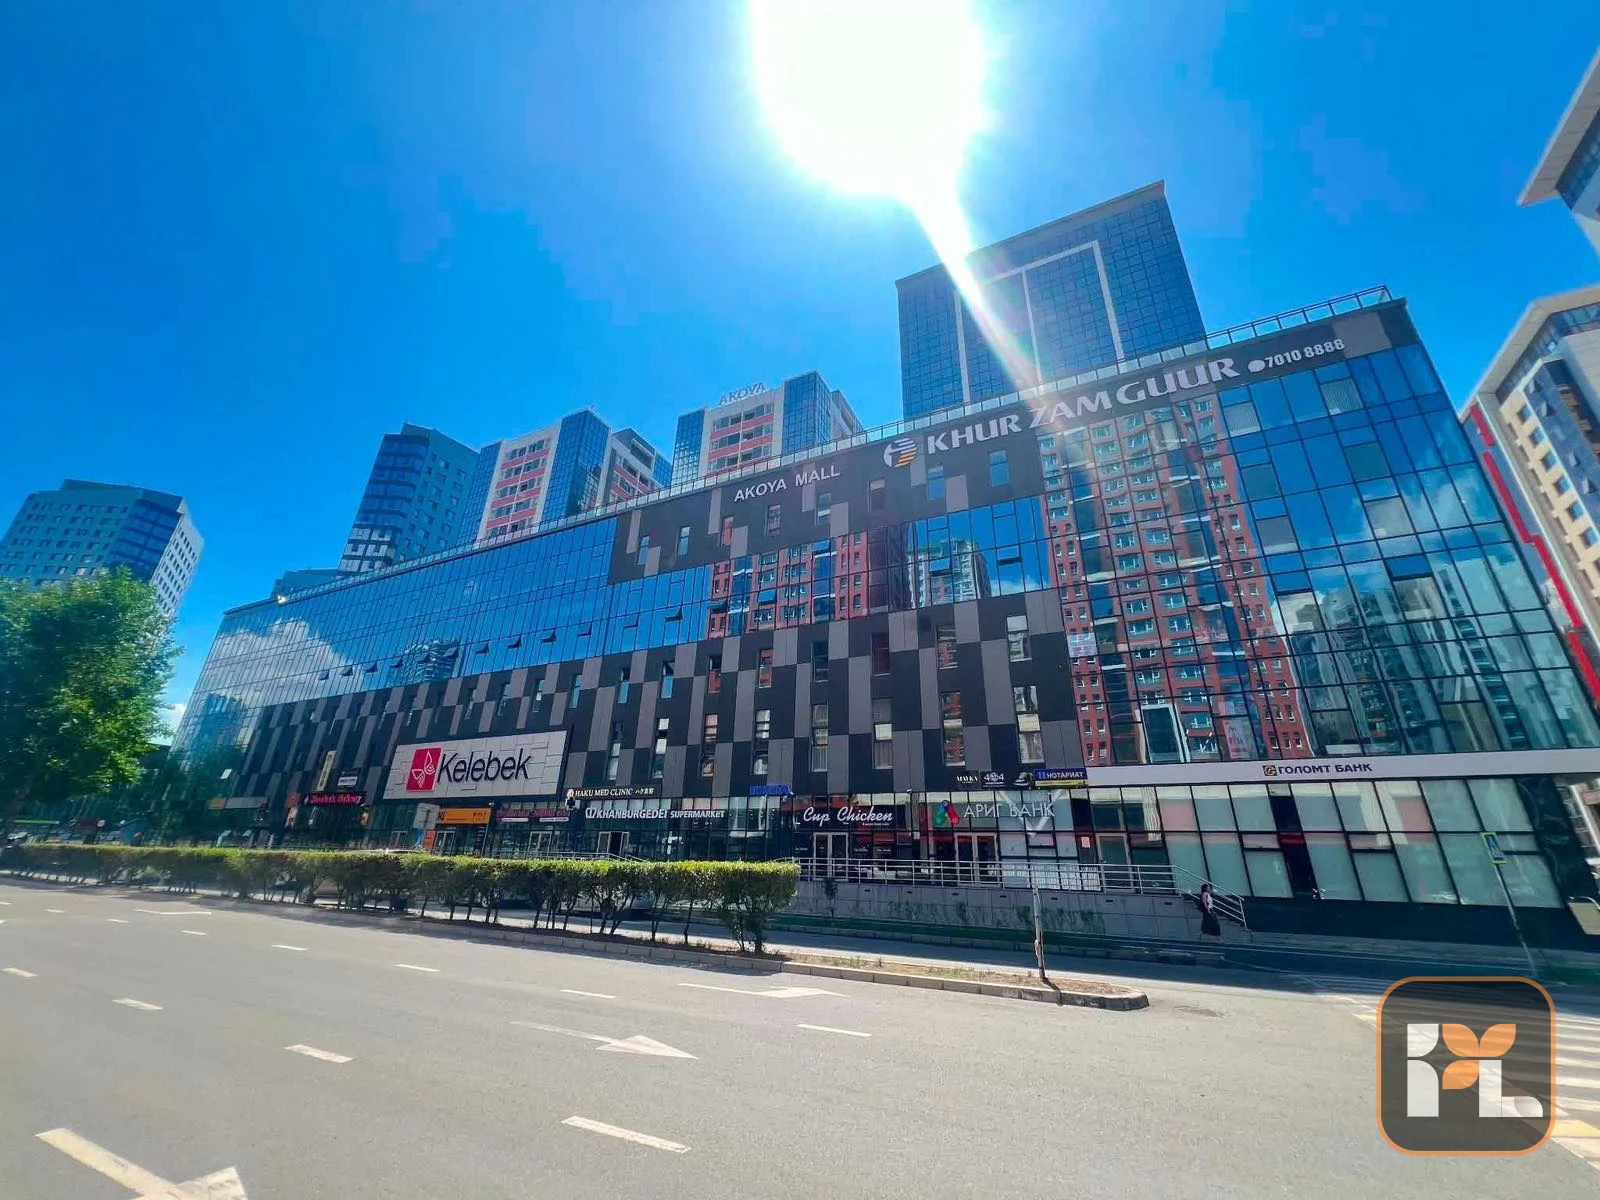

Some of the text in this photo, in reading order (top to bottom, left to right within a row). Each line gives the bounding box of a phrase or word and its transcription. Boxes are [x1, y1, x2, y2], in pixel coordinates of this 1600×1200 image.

[1264, 338, 1346, 369] 7010 8888
[719, 381, 768, 406] AKOYA
[927, 357, 1241, 454] KHUR ZAM GUUR
[734, 464, 841, 503] AKOYA MALL
[437, 748, 532, 784] Kelebek
[1047, 771, 1084, 779] НОТАРИАТ
[1278, 763, 1373, 775] ГОЛОМТ БАНК
[575, 789, 594, 797] HAKU
[594, 788, 609, 797] MED
[610, 787, 633, 796] CLINIC
[596, 808, 726, 819] KHANBURGEDEI SUPERMARKET
[803, 805, 893, 827] Cup Chicken
[963, 801, 1056, 818] АРИГ БАНК
